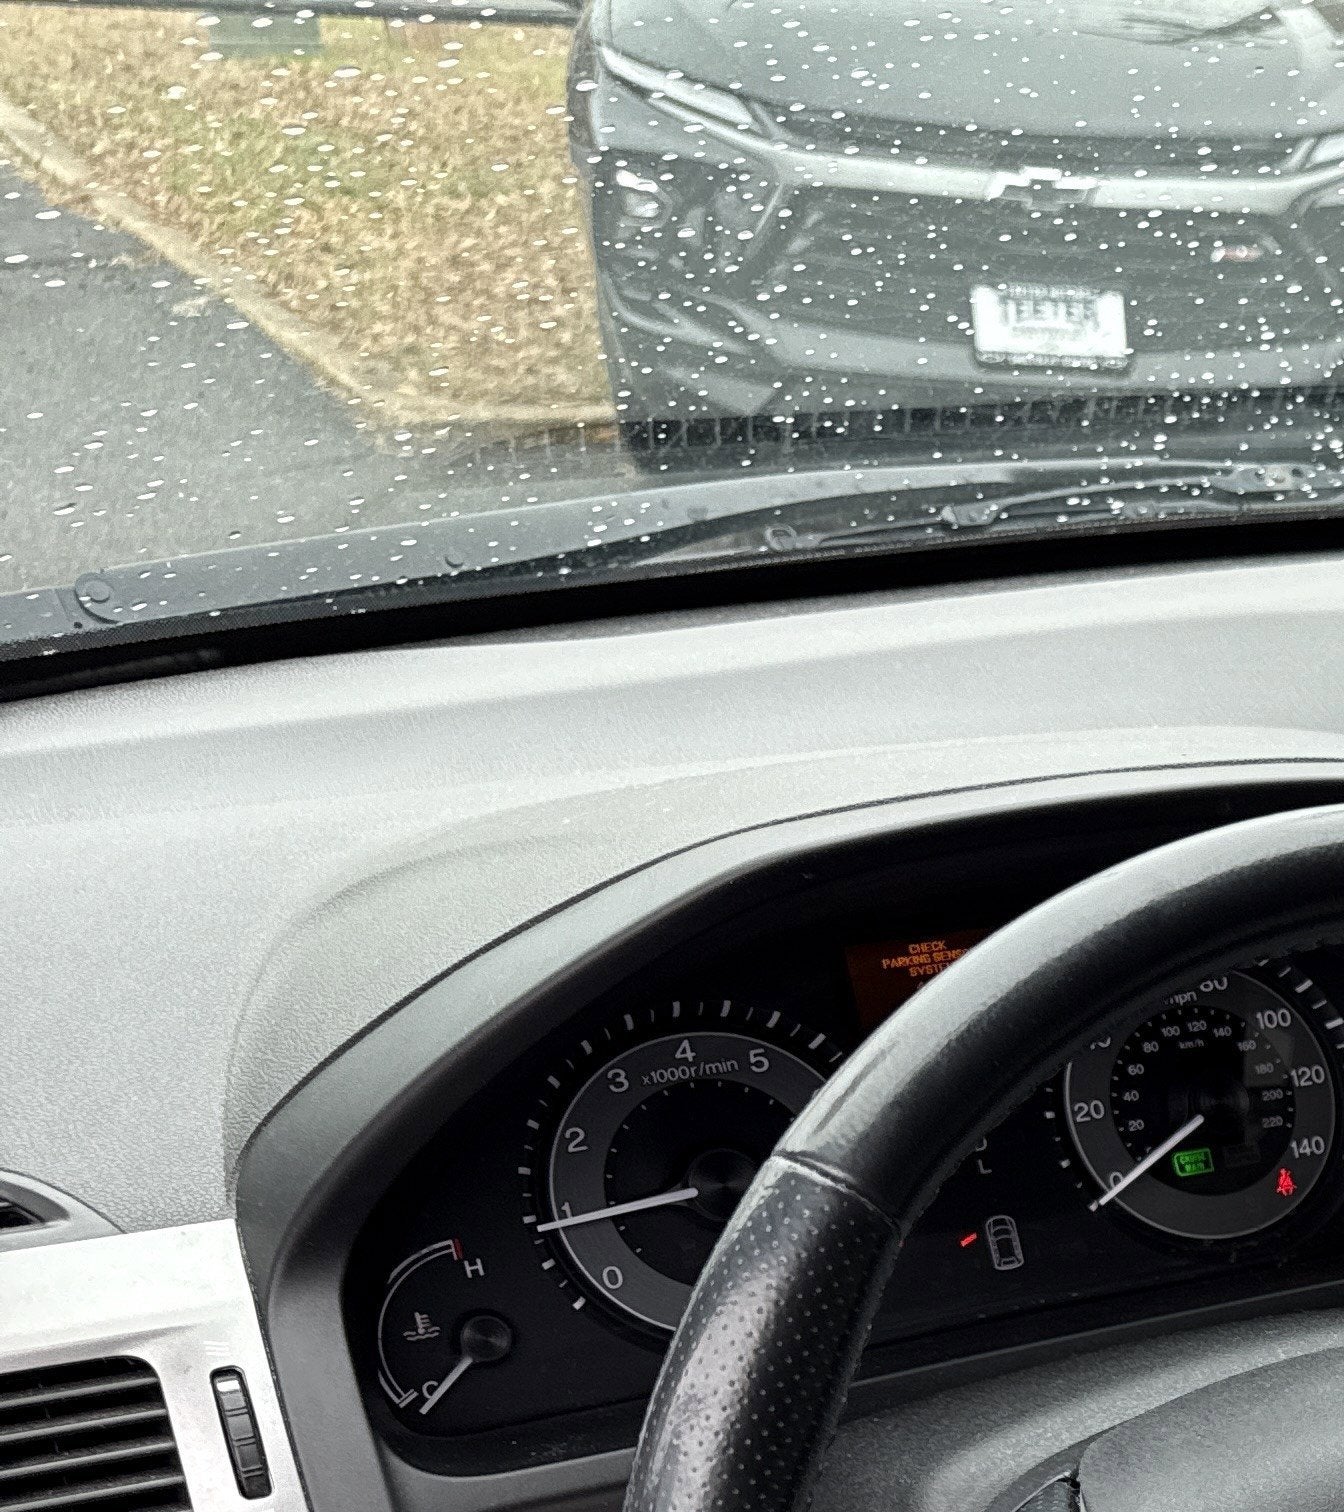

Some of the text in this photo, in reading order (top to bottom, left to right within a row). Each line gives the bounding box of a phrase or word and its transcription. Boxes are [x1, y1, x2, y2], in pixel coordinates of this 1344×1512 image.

[908, 940, 946, 954] CHECK
[882, 954, 931, 969] PARKING
[1187, 1020, 1207, 1032] 120
[1256, 1008, 1291, 1029] 100
[1161, 1026, 1180, 1038] 100
[1212, 1026, 1233, 1038] 140
[675, 1039, 695, 1063] 4
[1143, 1041, 1159, 1053] 80
[748, 1049, 769, 1073] 5
[1127, 1063, 1145, 1075] 60
[1290, 1065, 1326, 1087] 120
[606, 1068, 630, 1093] 3
[1123, 1090, 1140, 1102] 40
[1262, 1089, 1284, 1101] 200
[1073, 1100, 1105, 1122] 20
[1128, 1119, 1145, 1132] 20
[1262, 1116, 1284, 1128] 220
[564, 1127, 588, 1153] 2
[1290, 1136, 1326, 1158] 140
[464, 1258, 485, 1279] H
[602, 1264, 624, 1290] 0
